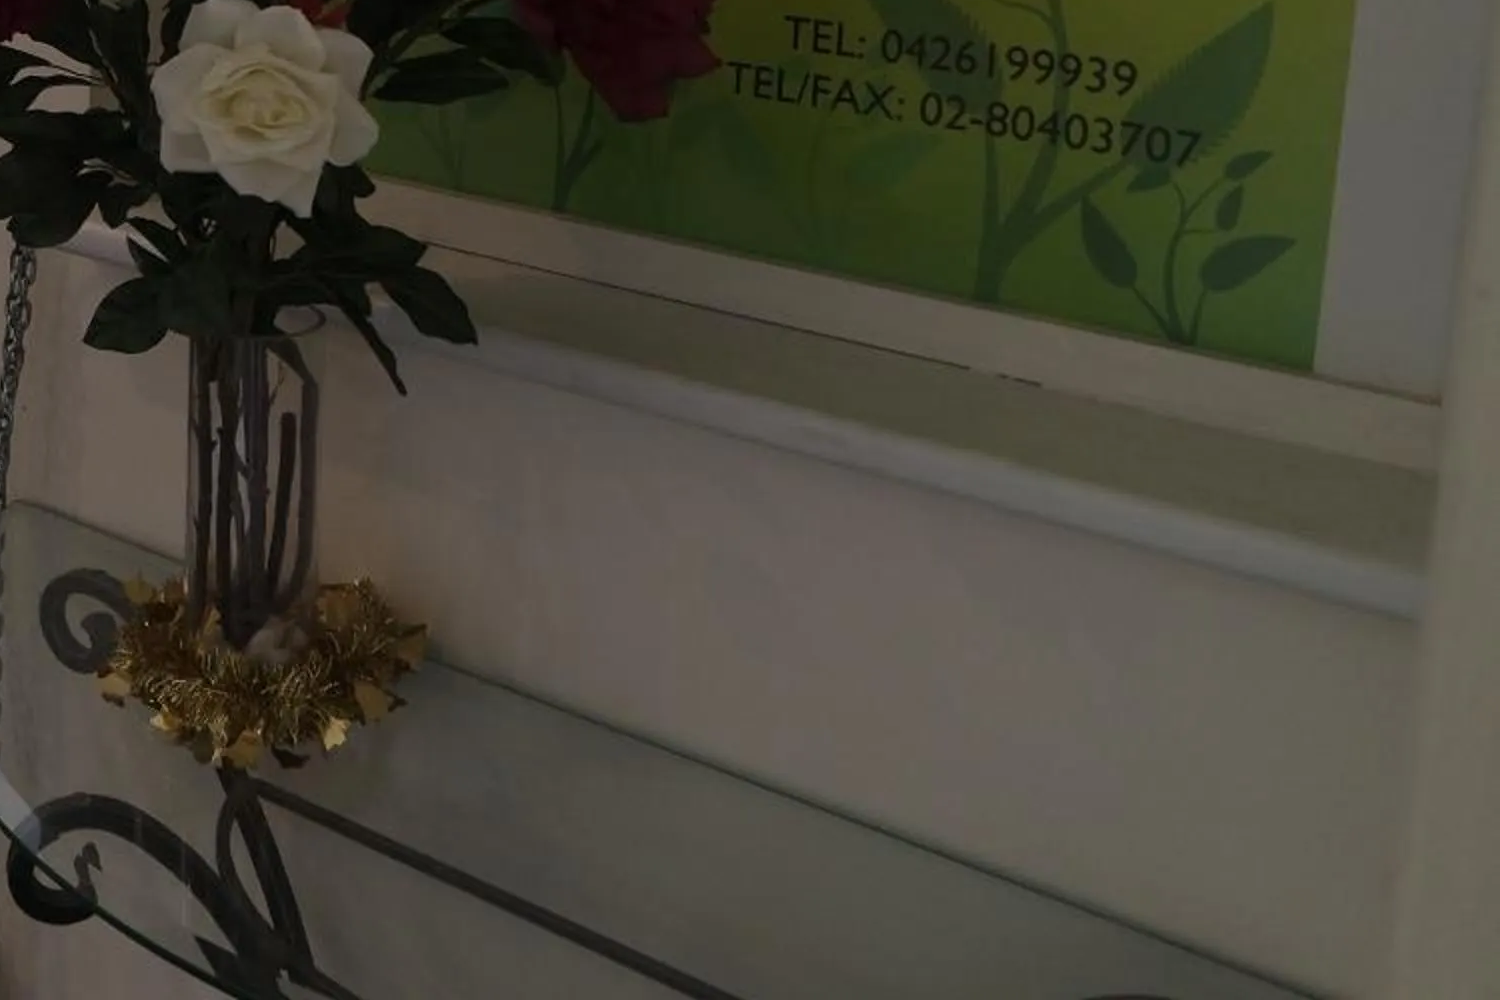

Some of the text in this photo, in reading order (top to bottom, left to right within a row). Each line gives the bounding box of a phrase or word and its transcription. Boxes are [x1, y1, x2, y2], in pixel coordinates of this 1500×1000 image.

[784, 15, 1137, 96] TEL: 0426199939
[727, 61, 1201, 168] TEL/FAX: 02-80403707
